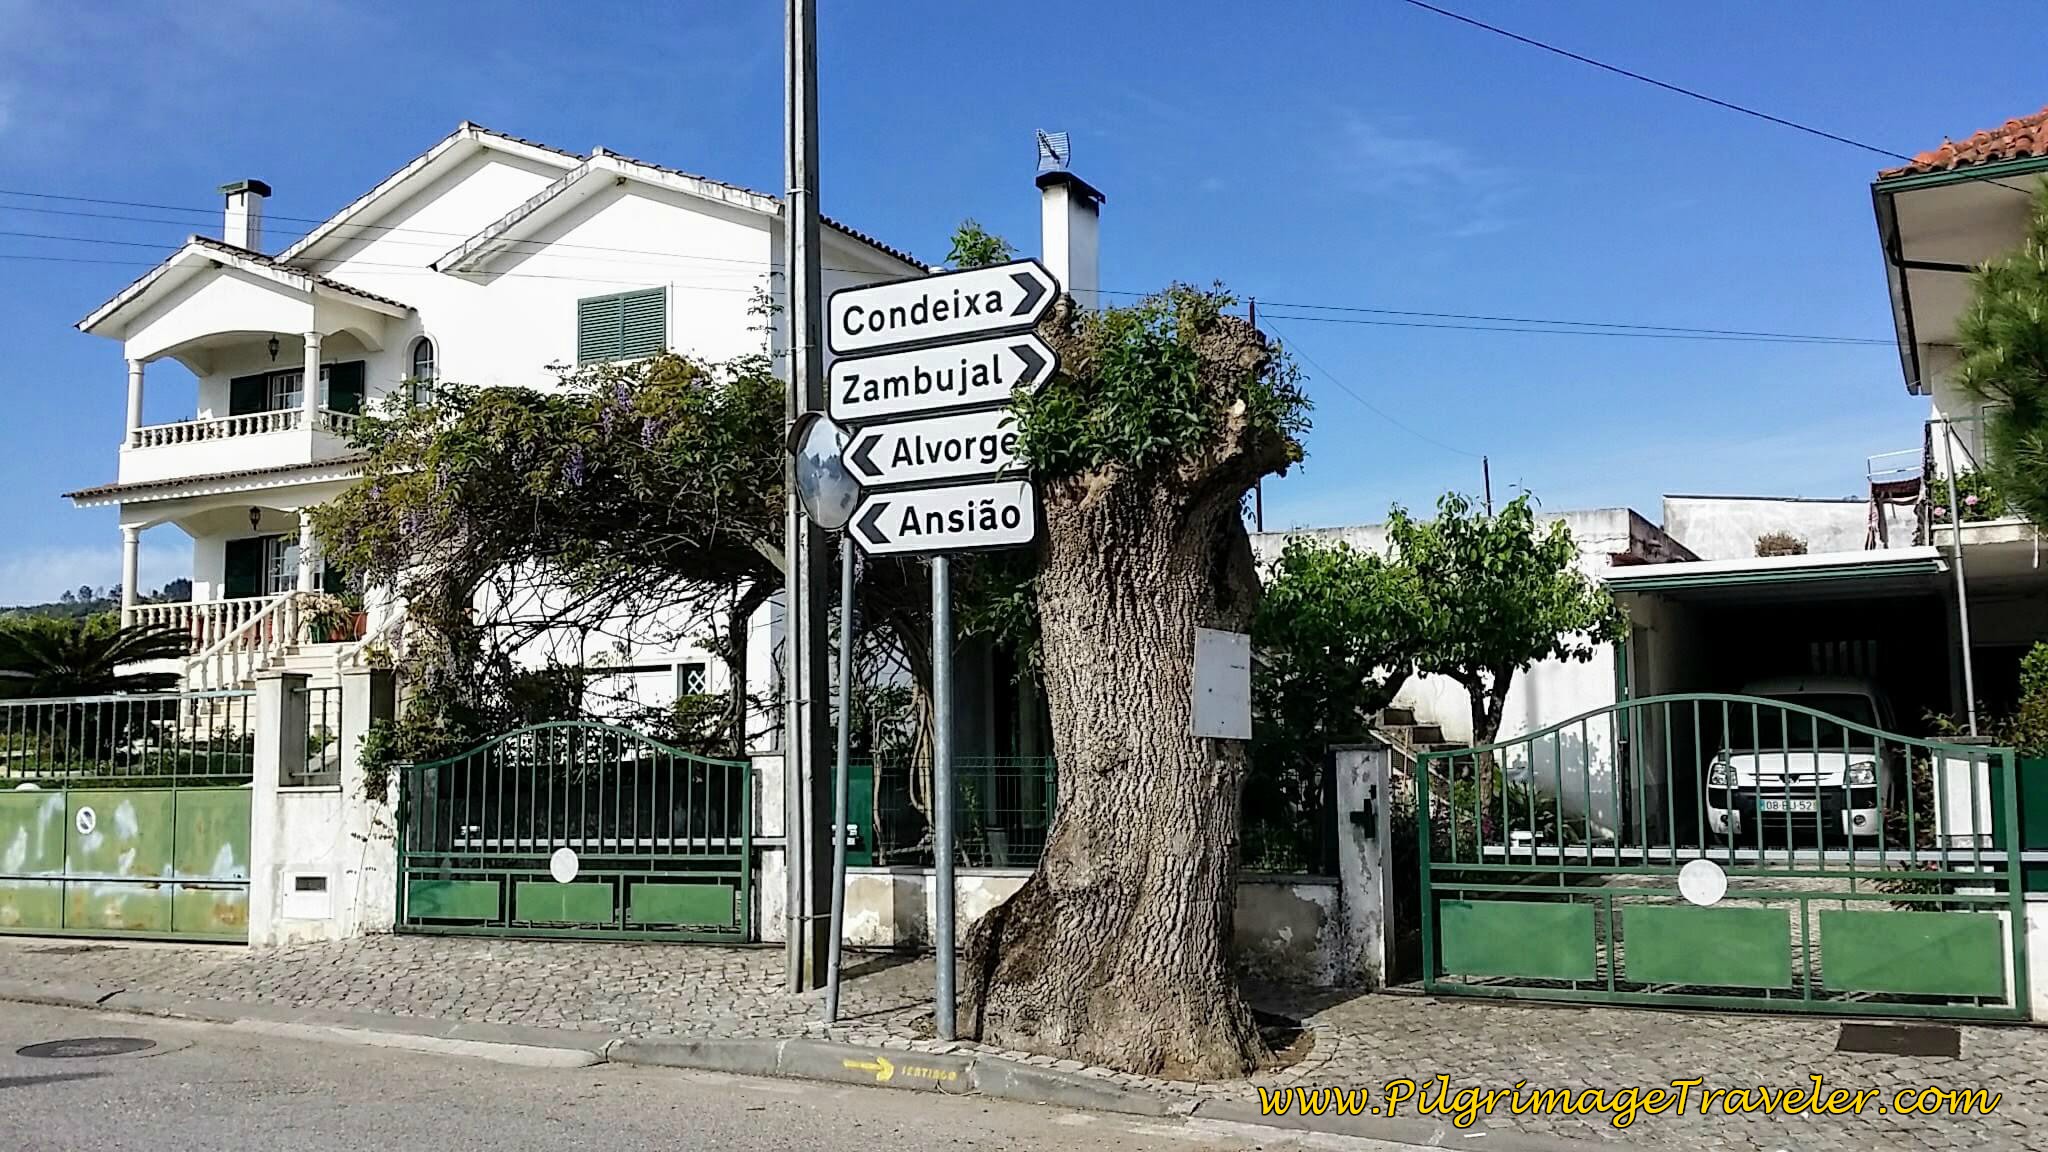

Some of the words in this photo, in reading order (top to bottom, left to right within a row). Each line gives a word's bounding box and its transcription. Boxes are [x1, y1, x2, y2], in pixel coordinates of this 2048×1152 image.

[842, 288, 1003, 336] Condeixa
[842, 354, 1003, 404] Zambujal
[891, 430, 1018, 469] Alvorge
[898, 498, 1021, 537] Ansião
